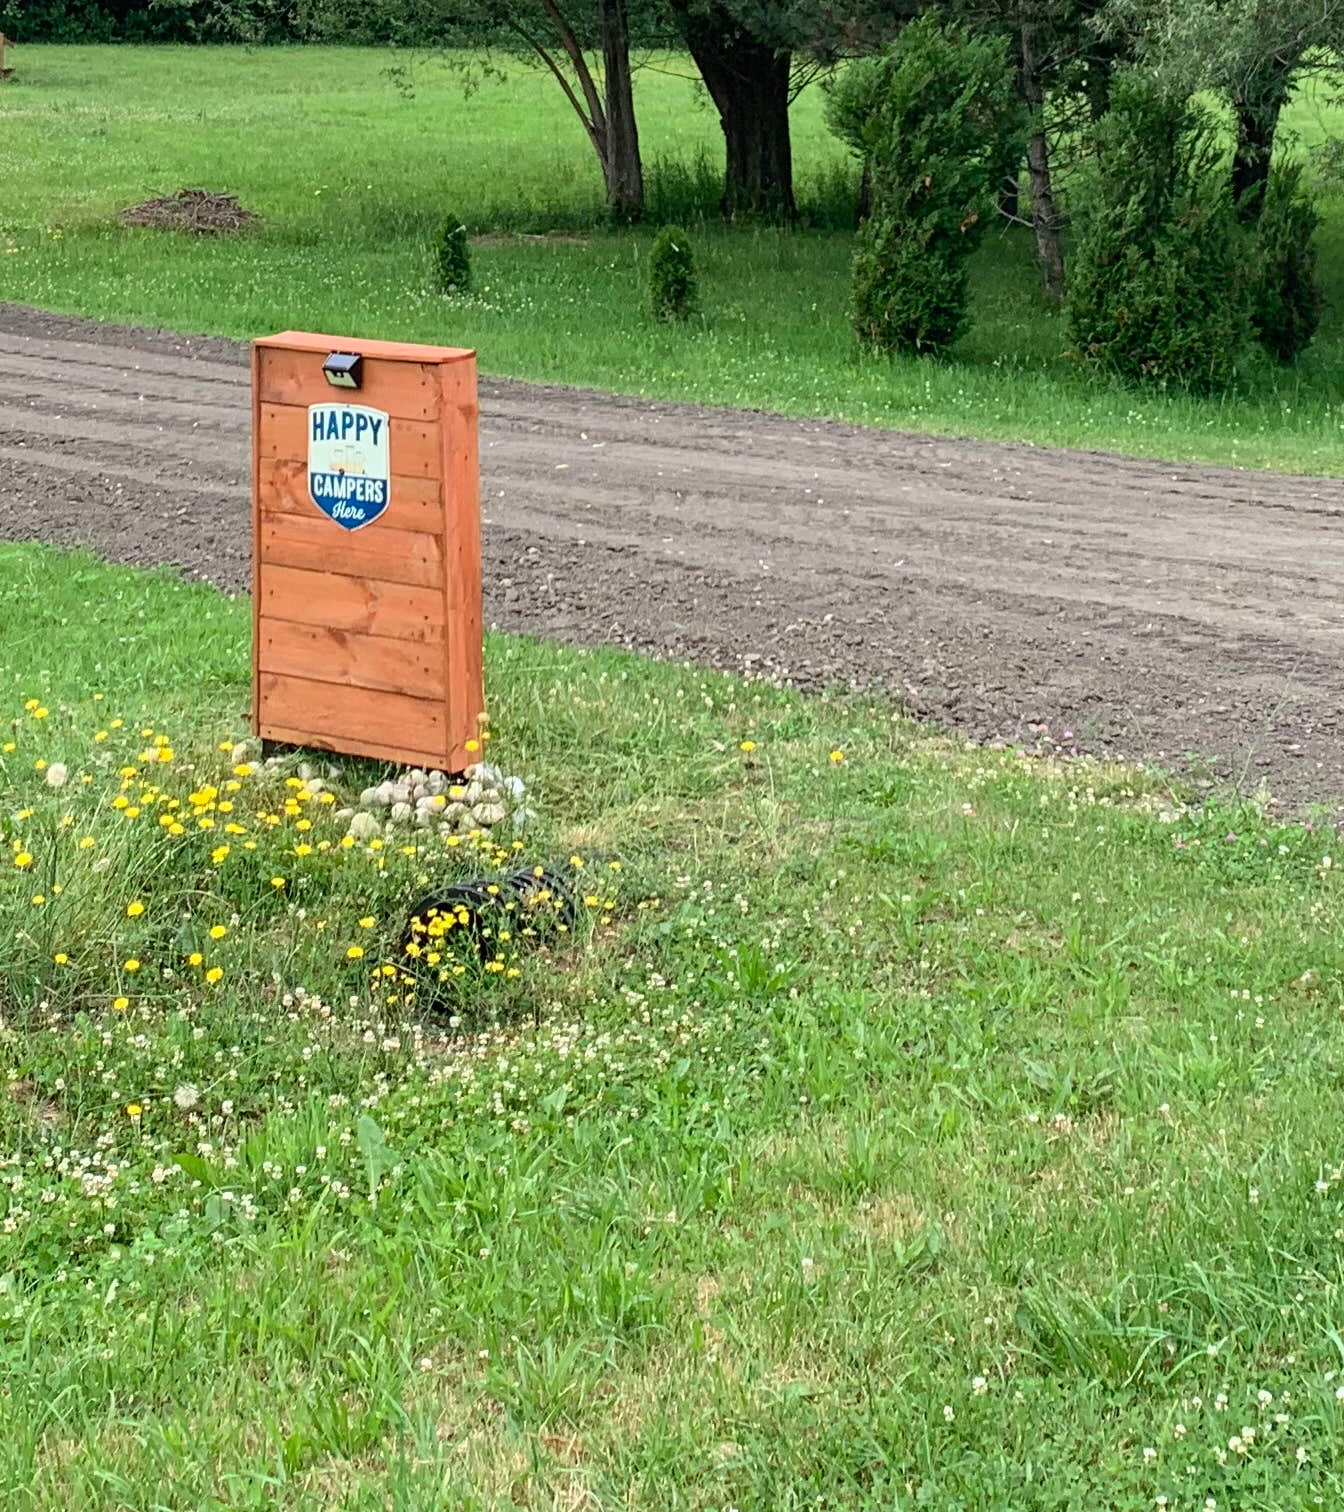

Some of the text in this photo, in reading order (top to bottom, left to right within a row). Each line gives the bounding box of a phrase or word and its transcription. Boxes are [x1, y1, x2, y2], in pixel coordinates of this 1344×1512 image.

[313, 411, 382, 446] HAPPY
[314, 475, 383, 503] CAMPERS
[332, 501, 366, 520] Here
